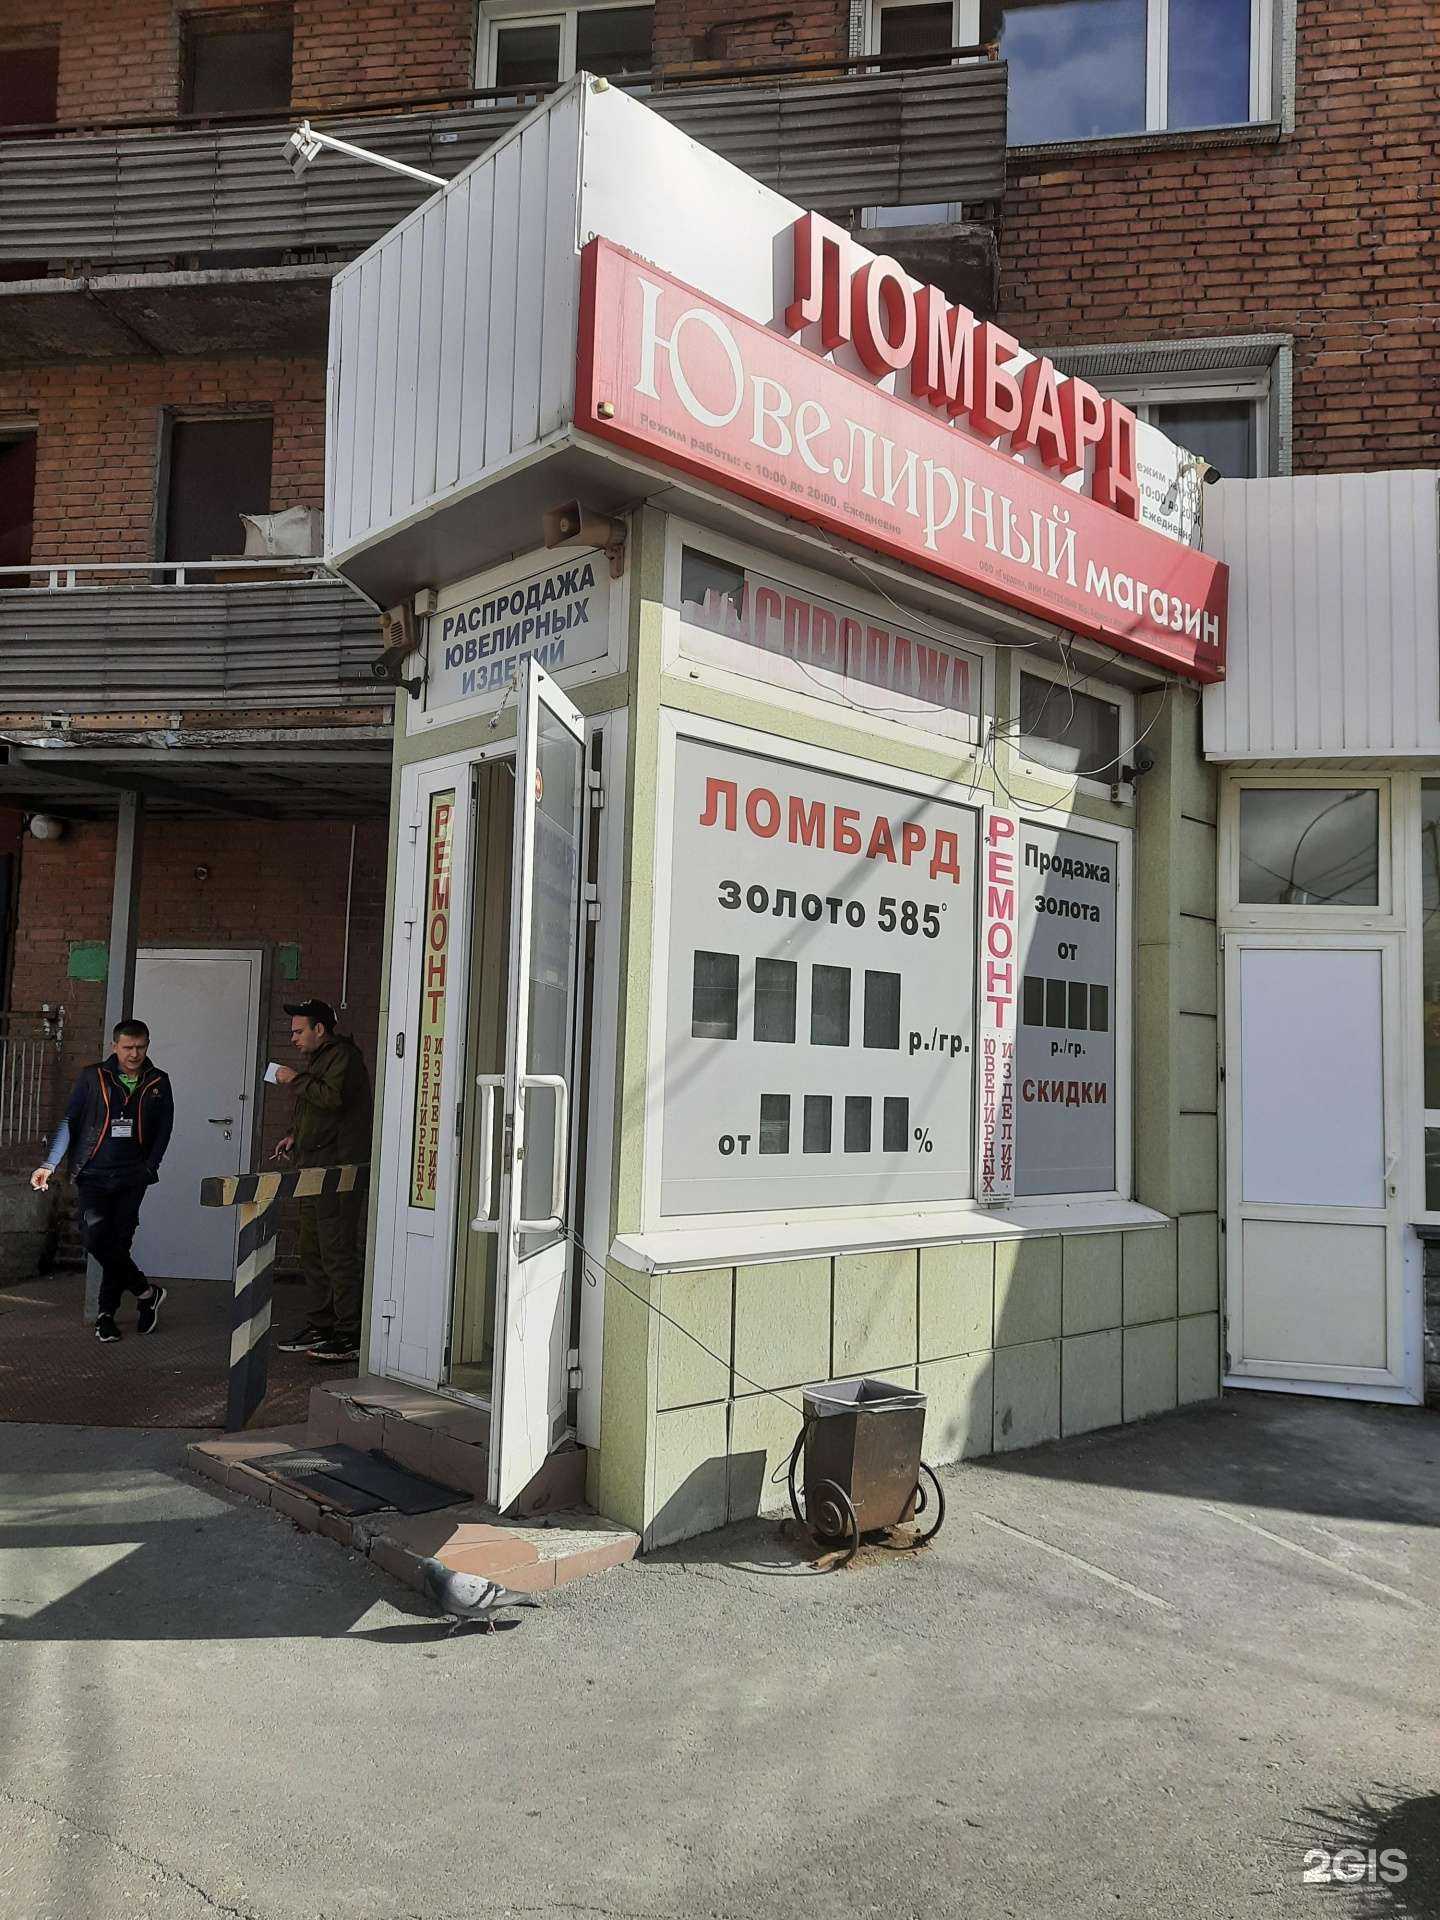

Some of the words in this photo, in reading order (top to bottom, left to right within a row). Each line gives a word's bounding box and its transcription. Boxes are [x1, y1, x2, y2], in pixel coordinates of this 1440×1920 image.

[794, 209, 1139, 520] ЛОМБАРД
[640, 413, 687, 444] Режим
[690, 436, 741, 465] работы:
[756, 463, 787, 486] 10:00
[790, 480, 804, 494] до
[842, 501, 902, 534] Ежедневно
[442, 563, 595, 641] РАСПРОДАЖА
[444, 598, 590, 669] ЮВЕЛИРНЫХ
[1085, 560, 1219, 647] магазин
[700, 777, 961, 884] ЛОМБАРД
[1025, 843, 1110, 883] Продажа
[427, 804, 450, 1024] РЕМОНТ
[986, 815, 1015, 1028] РЕМОНТ
[1034, 895, 1100, 923] золота
[1057, 942, 1078, 960] от
[909, 1027, 970, 1057] р./гр.
[415, 1034, 432, 1201] ЮВЕЛИРНЫХ
[427, 1037, 444, 1191] ИЗДЕЛИЙ
[718, 1134, 752, 1155] от
[914, 1128, 934, 1153] %
[982, 1038, 996, 1193] ЮВЕЛИРНЫХ
[1000, 1042, 1014, 1182] ИЗДЕЛИЙ
